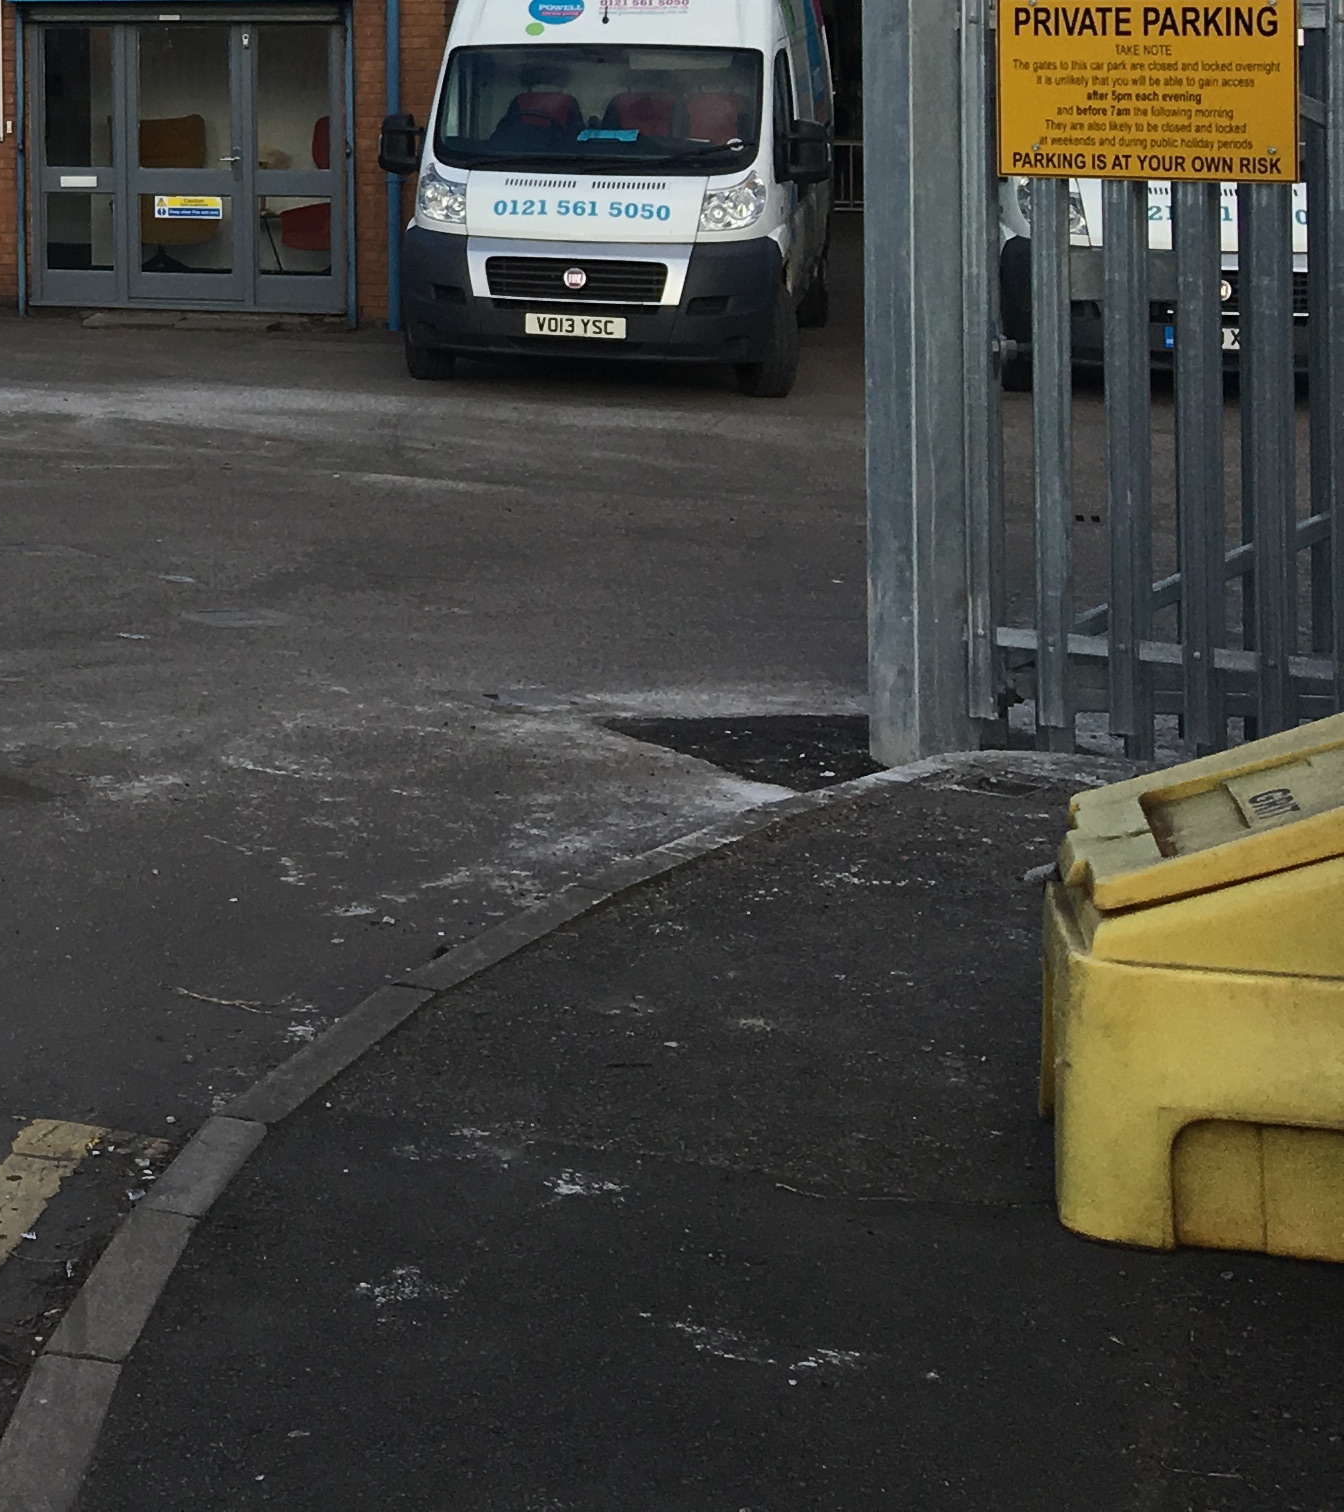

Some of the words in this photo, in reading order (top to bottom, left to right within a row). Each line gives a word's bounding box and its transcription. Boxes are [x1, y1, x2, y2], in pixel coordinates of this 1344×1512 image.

[538, 3, 584, 12] POWELL
[1014, 6, 1132, 36] PRIVATE
[1143, 6, 1278, 37] PARKING
[1115, 44, 1140, 56] TAKE
[1143, 44, 1172, 56] NOTE
[1013, 58, 1030, 70] The
[1032, 60, 1057, 73] gates
[1059, 60, 1069, 70] to
[1071, 59, 1088, 70] this
[1089, 61, 1105, 71] car
[1107, 60, 1127, 73] park
[1129, 61, 1145, 71] are
[1148, 61, 1178, 72] closed
[1181, 61, 1199, 72] and
[1201, 61, 1233, 72] locked
[1235, 61, 1281, 76] overnight
[1045, 75, 1052, 85] is
[1054, 75, 1089, 88] unlikely
[1091, 75, 1110, 86] that
[1112, 77, 1129, 88] you
[1131, 75, 1146, 86] will
[1149, 76, 1161, 86] be
[1163, 76, 1183, 87] able
[1186, 76, 1196, 86] to
[1198, 76, 1219, 89] gain
[1221, 77, 1255, 88] access
[1086, 89, 1109, 101] after
[1111, 89, 1133, 103] 5pm
[1135, 91, 1159, 102] each
[1161, 91, 1202, 105] evening
[1057, 105, 1074, 116] and
[1076, 105, 1108, 116] before
[1110, 105, 1131, 116] 7am
[1133, 106, 1148, 117] the
[1151, 106, 1192, 120] following
[1195, 107, 1234, 121] morning
[1045, 119, 1067, 133] They
[1070, 122, 1085, 131] are
[1087, 120, 1107, 131] also
[1109, 120, 1133, 134] likely
[1135, 121, 1144, 132] to
[1147, 122, 1159, 132] be
[1161, 122, 1192, 133] closed
[1194, 123, 1212, 134] and
[1215, 123, 1246, 134] locked
[1039, 135, 1048, 145] at
[1050, 135, 1096, 146] weekends
[1099, 136, 1116, 146] and
[1118, 136, 1147, 149] during
[1150, 137, 1178, 149] public
[1181, 137, 1214, 151] holiday
[1217, 139, 1253, 151] periods
[1013, 152, 1086, 170] PARKING
[1091, 153, 1107, 170] IS
[1111, 154, 1132, 170] AT
[1137, 155, 1186, 172] YOUR
[1191, 156, 1233, 173] OWN
[1240, 156, 1282, 175] RISK
[493, 199, 548, 216] 0121
[556, 200, 599, 217] 561
[608, 201, 671, 221] 5050
[536, 316, 575, 334] VO13
[581, 318, 615, 336] YSC
